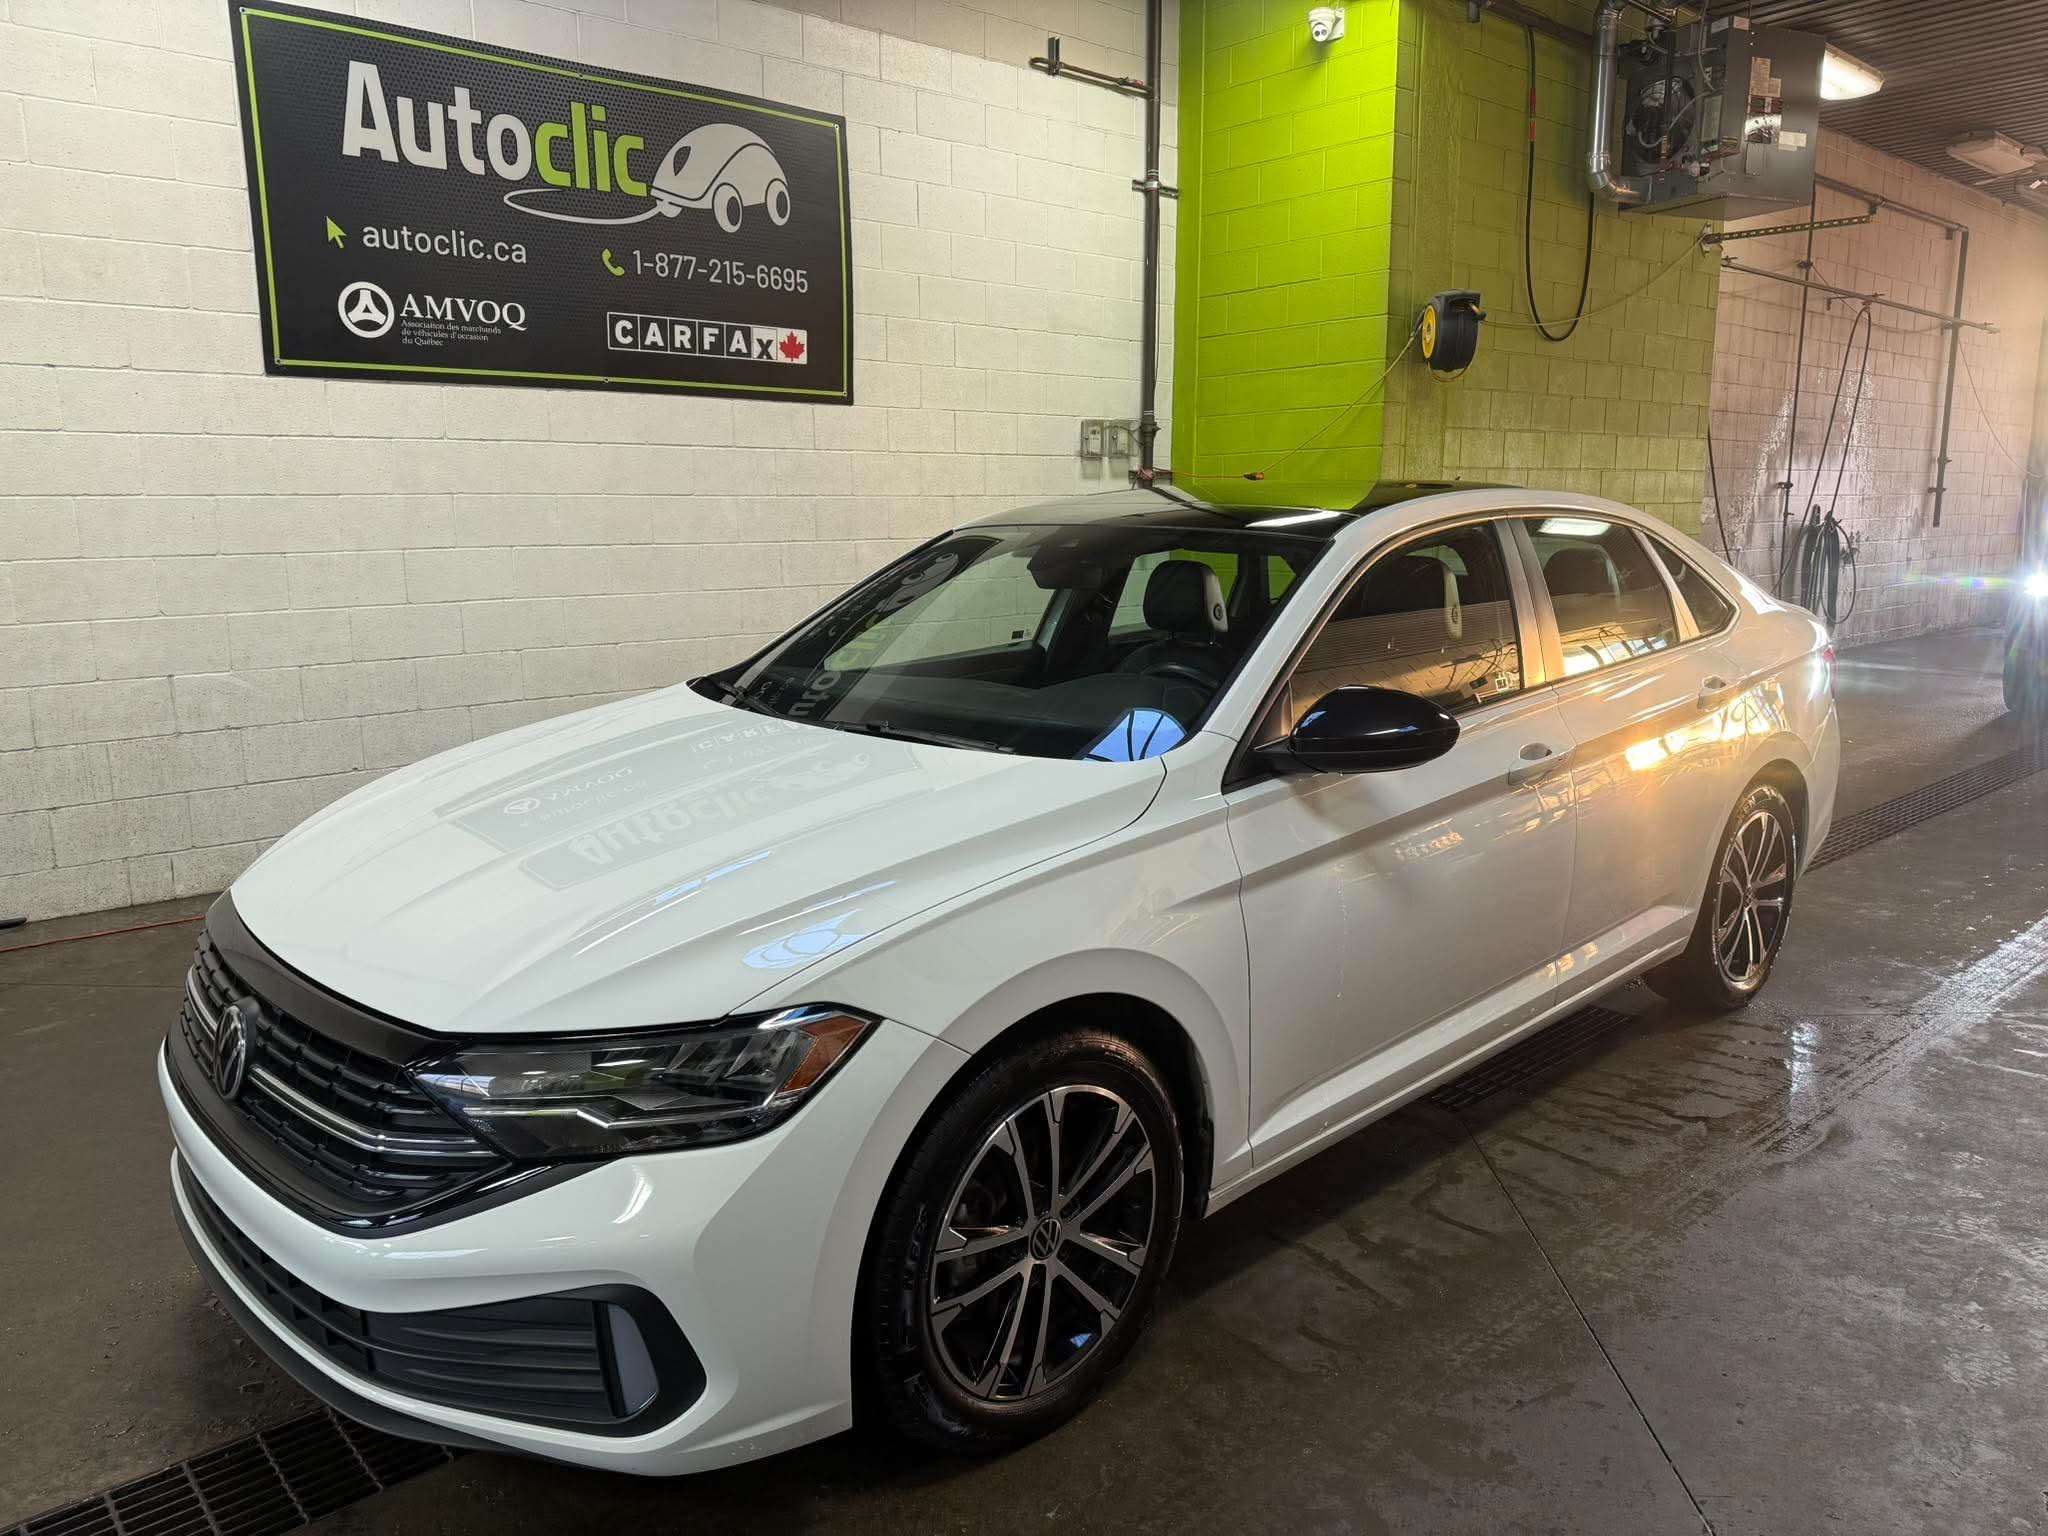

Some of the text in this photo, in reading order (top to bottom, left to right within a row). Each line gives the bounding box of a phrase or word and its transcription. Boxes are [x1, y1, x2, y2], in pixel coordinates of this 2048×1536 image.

[342, 60, 648, 197] Autoclic
[362, 225, 527, 264] autoclic.ca
[633, 250, 808, 293] 1-877-215-6695
[400, 293, 527, 331] AMVOQ
[401, 319, 501, 335] Association des marchands
[402, 336, 413, 344] du
[614, 319, 774, 360] CARFAX
